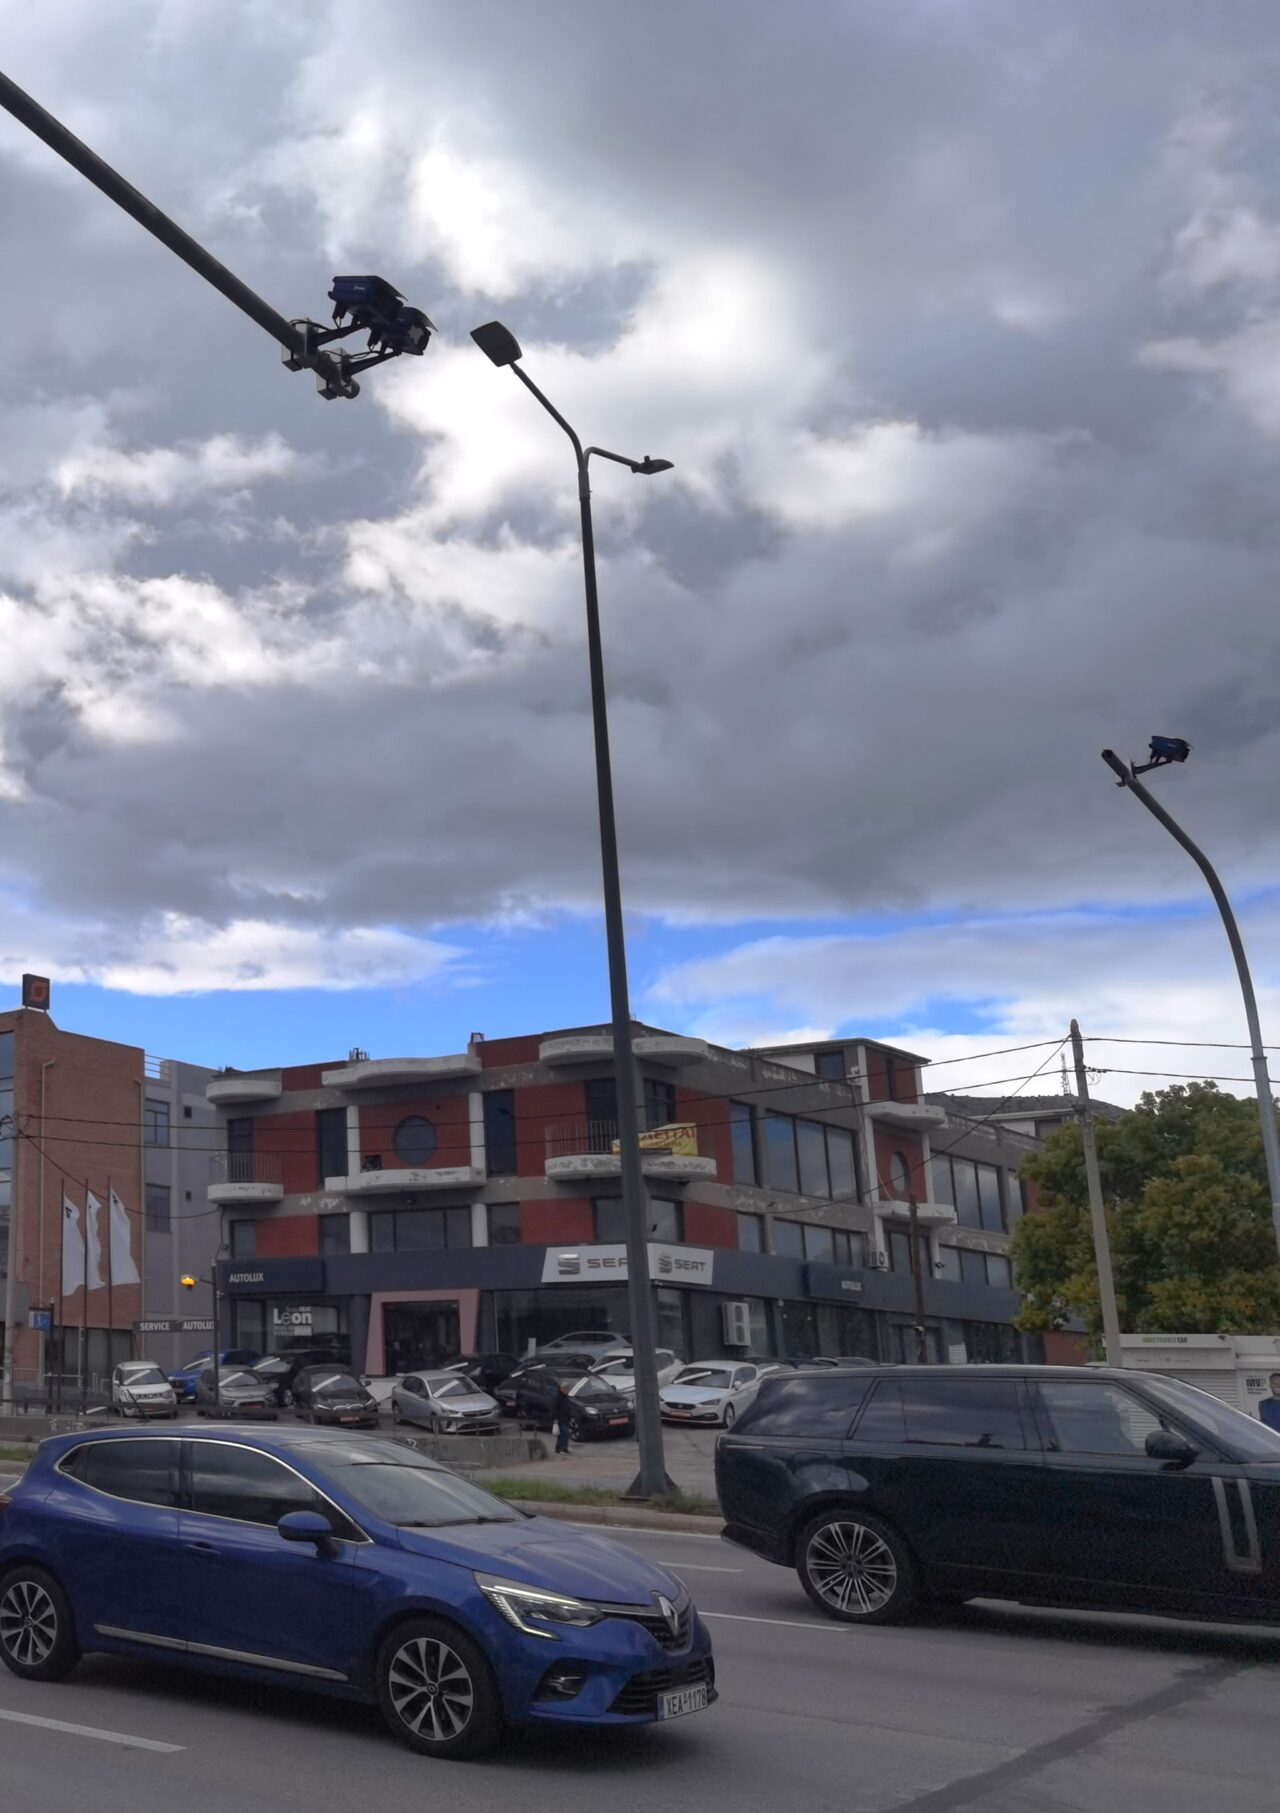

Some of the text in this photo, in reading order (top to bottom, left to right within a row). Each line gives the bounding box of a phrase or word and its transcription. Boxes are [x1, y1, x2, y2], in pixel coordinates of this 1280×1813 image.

[587, 1258, 628, 1269] SEA
[675, 1259, 706, 1272] SEAT
[229, 1273, 264, 1283] AUTOLUX
[273, 1308, 312, 1324] Leon
[140, 1322, 170, 1331] SERVICE
